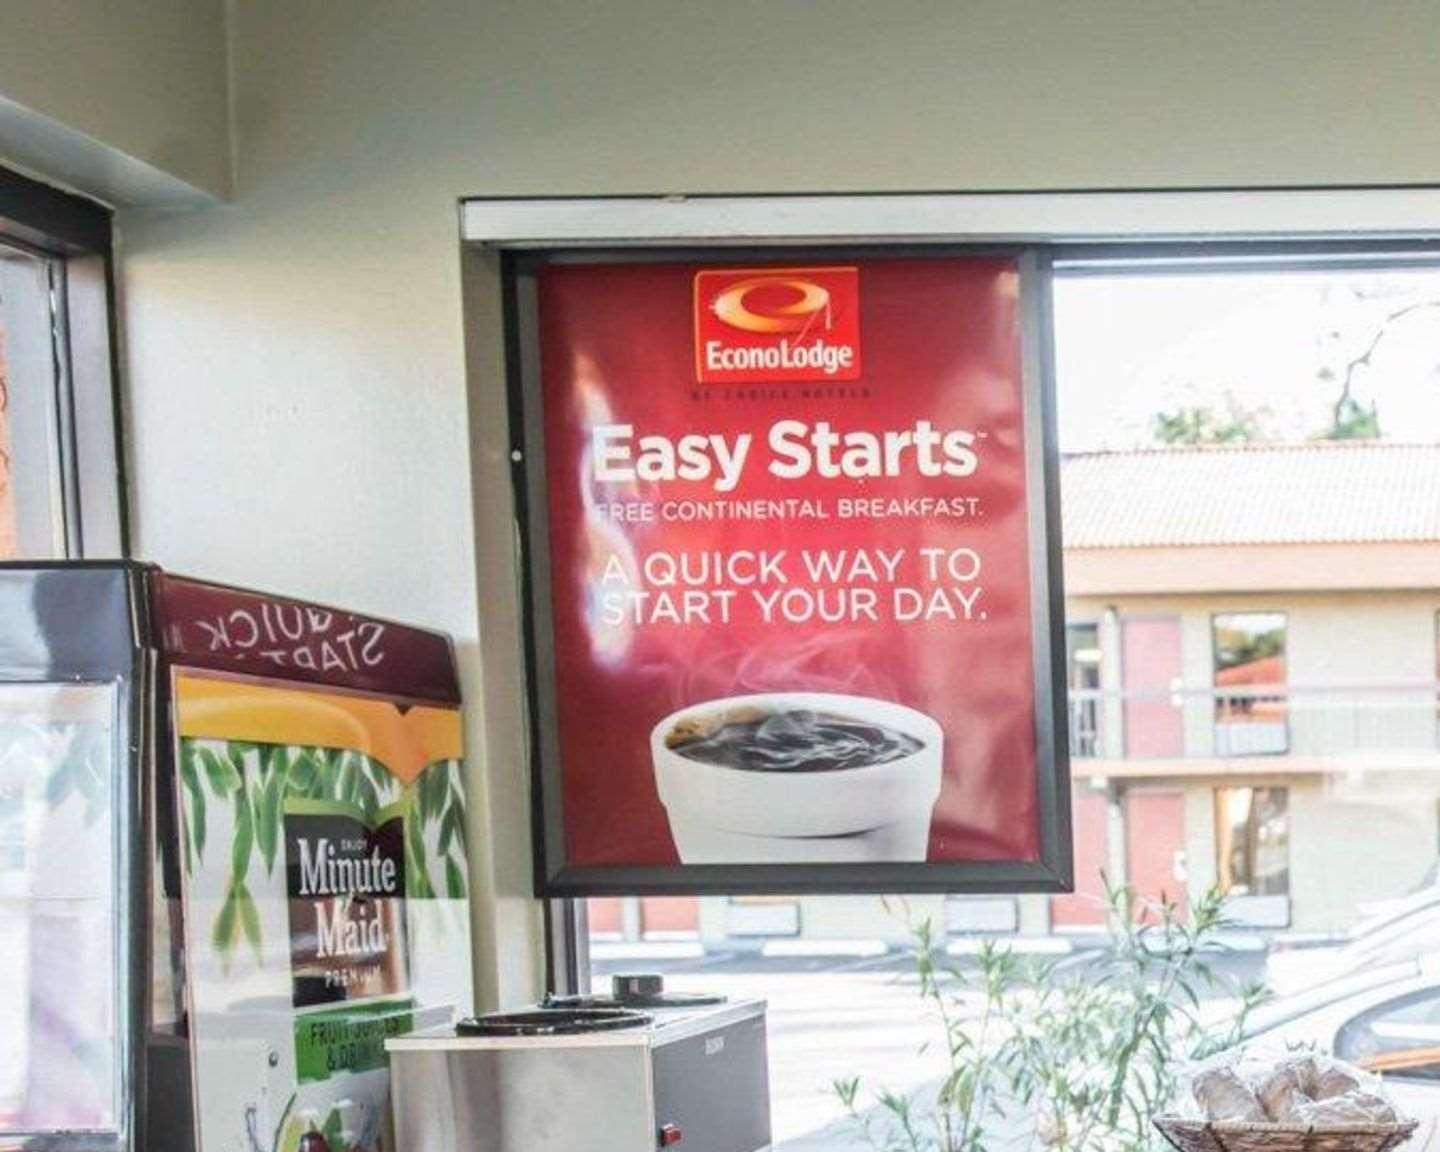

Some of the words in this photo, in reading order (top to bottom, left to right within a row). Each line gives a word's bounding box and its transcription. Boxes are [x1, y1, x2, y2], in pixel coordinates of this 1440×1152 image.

[706, 338, 854, 375] EconoLodge
[592, 424, 751, 491] Easy
[598, 501, 655, 523] FREE
[661, 500, 829, 521] CONTINENTAL
[837, 497, 984, 519] BREAKFAST.
[601, 554, 631, 586] A
[644, 549, 789, 587] QUICK
[801, 548, 906, 583] WAY
[919, 547, 982, 583] TO
[601, 590, 738, 625] START
[751, 588, 879, 622] YOUR
[893, 586, 988, 621] DAY.
[297, 838, 397, 896] Minute
[314, 898, 387, 959] Maid
